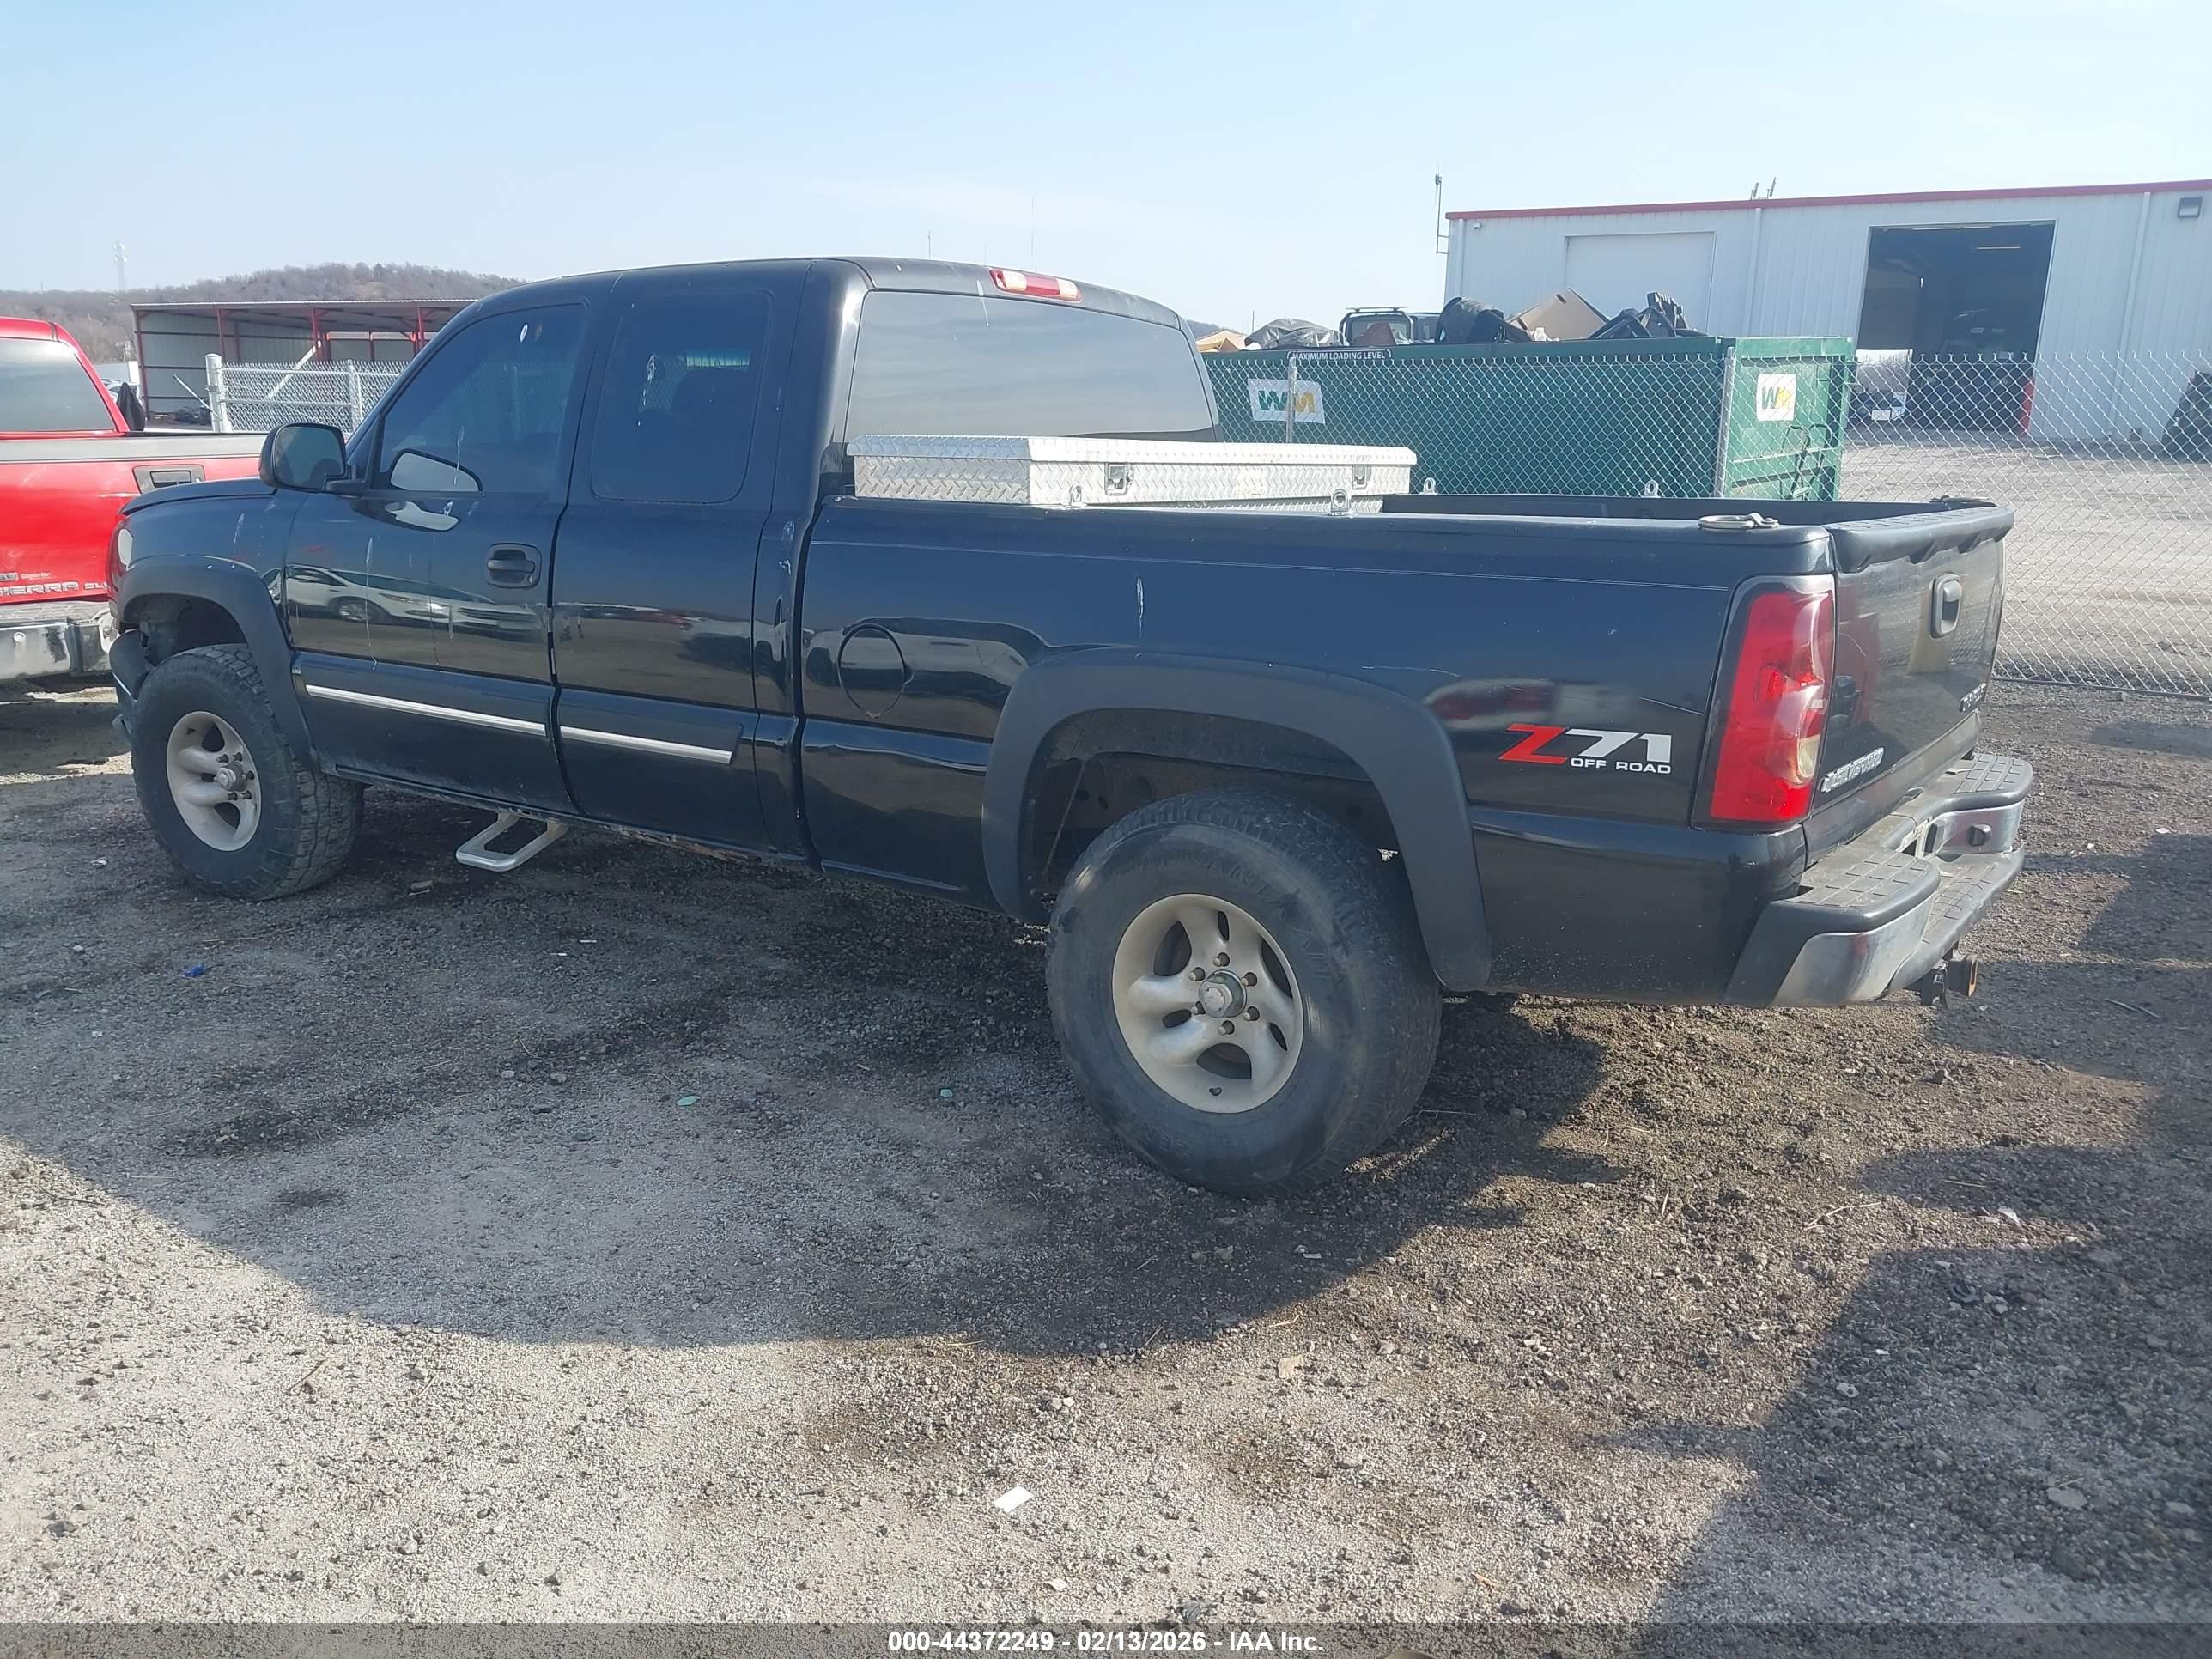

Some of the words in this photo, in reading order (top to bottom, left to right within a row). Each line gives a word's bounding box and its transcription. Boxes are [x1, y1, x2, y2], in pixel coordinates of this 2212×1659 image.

[1329, 351, 1363, 360] LOADING
[1363, 350, 1386, 359] LEVEL
[1257, 389, 1316, 413] WM
[0, 582, 79, 597] IERRA
[1497, 723, 1672, 765] Z71
[1570, 757, 1607, 769] OFF
[1615, 761, 1672, 775] ROAD
